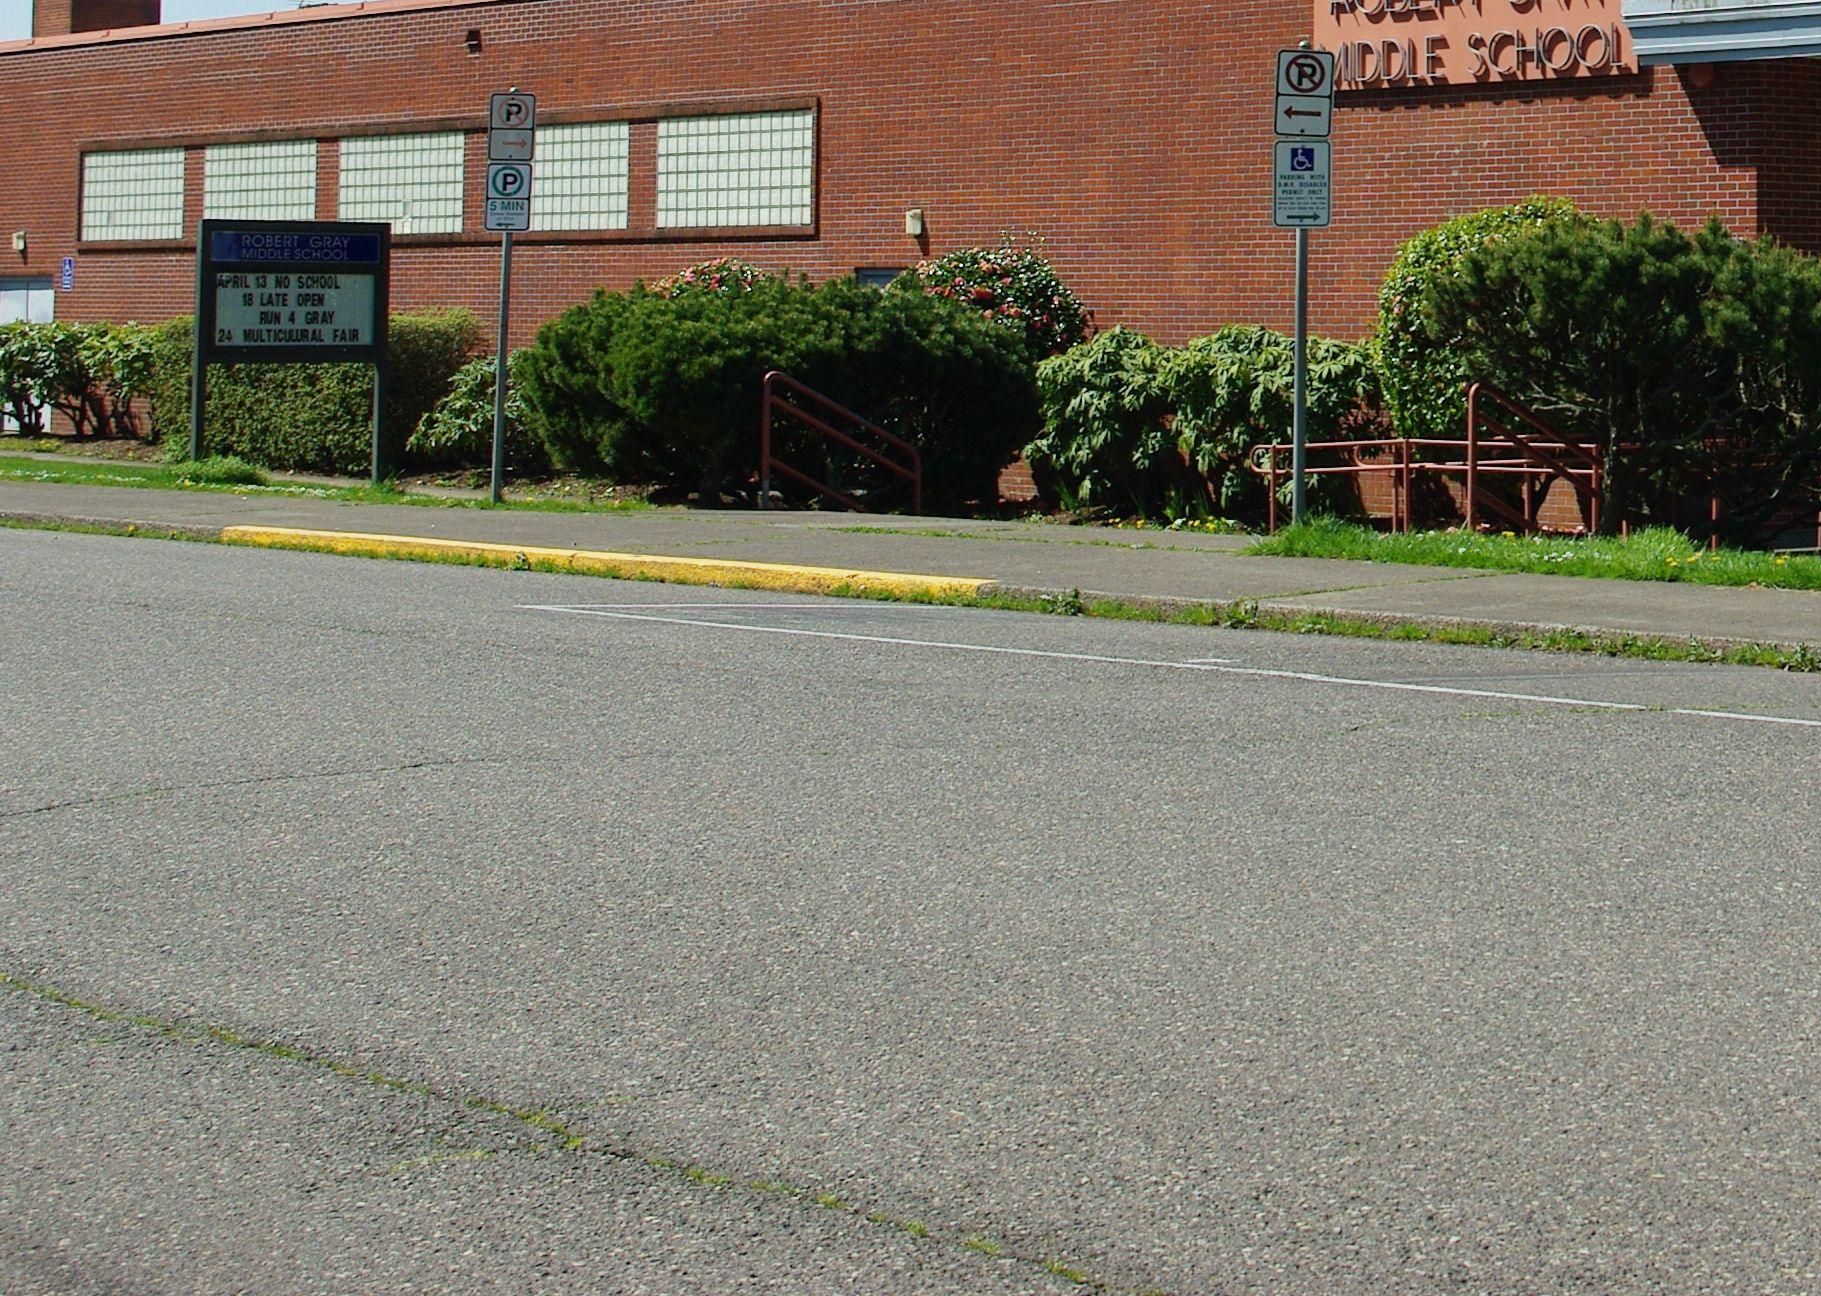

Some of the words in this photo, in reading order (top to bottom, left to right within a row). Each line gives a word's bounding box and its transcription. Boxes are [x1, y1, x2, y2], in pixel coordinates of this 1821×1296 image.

[1466, 22, 1628, 76] SCHOOL
[490, 201, 497, 211] 5
[501, 200, 524, 211] MIN
[241, 235, 298, 248] ROBERT
[309, 235, 350, 249] GRAY
[241, 249, 291, 260] MIDDLE
[294, 249, 349, 260] SCHOOL
[217, 275, 250, 288] APRIL
[255, 275, 267, 288] 13
[275, 275, 290, 289] NO
[298, 276, 340, 289] SCHOOL
[242, 293, 254, 307] 18
[260, 293, 288, 306] LATE
[297, 293, 325, 306] OPEN
[259, 311, 281, 324] RUN
[288, 311, 295, 324] 4
[305, 311, 335, 324] GRAY
[217, 329, 232, 343] 24
[333, 329, 359, 343] FAIR
